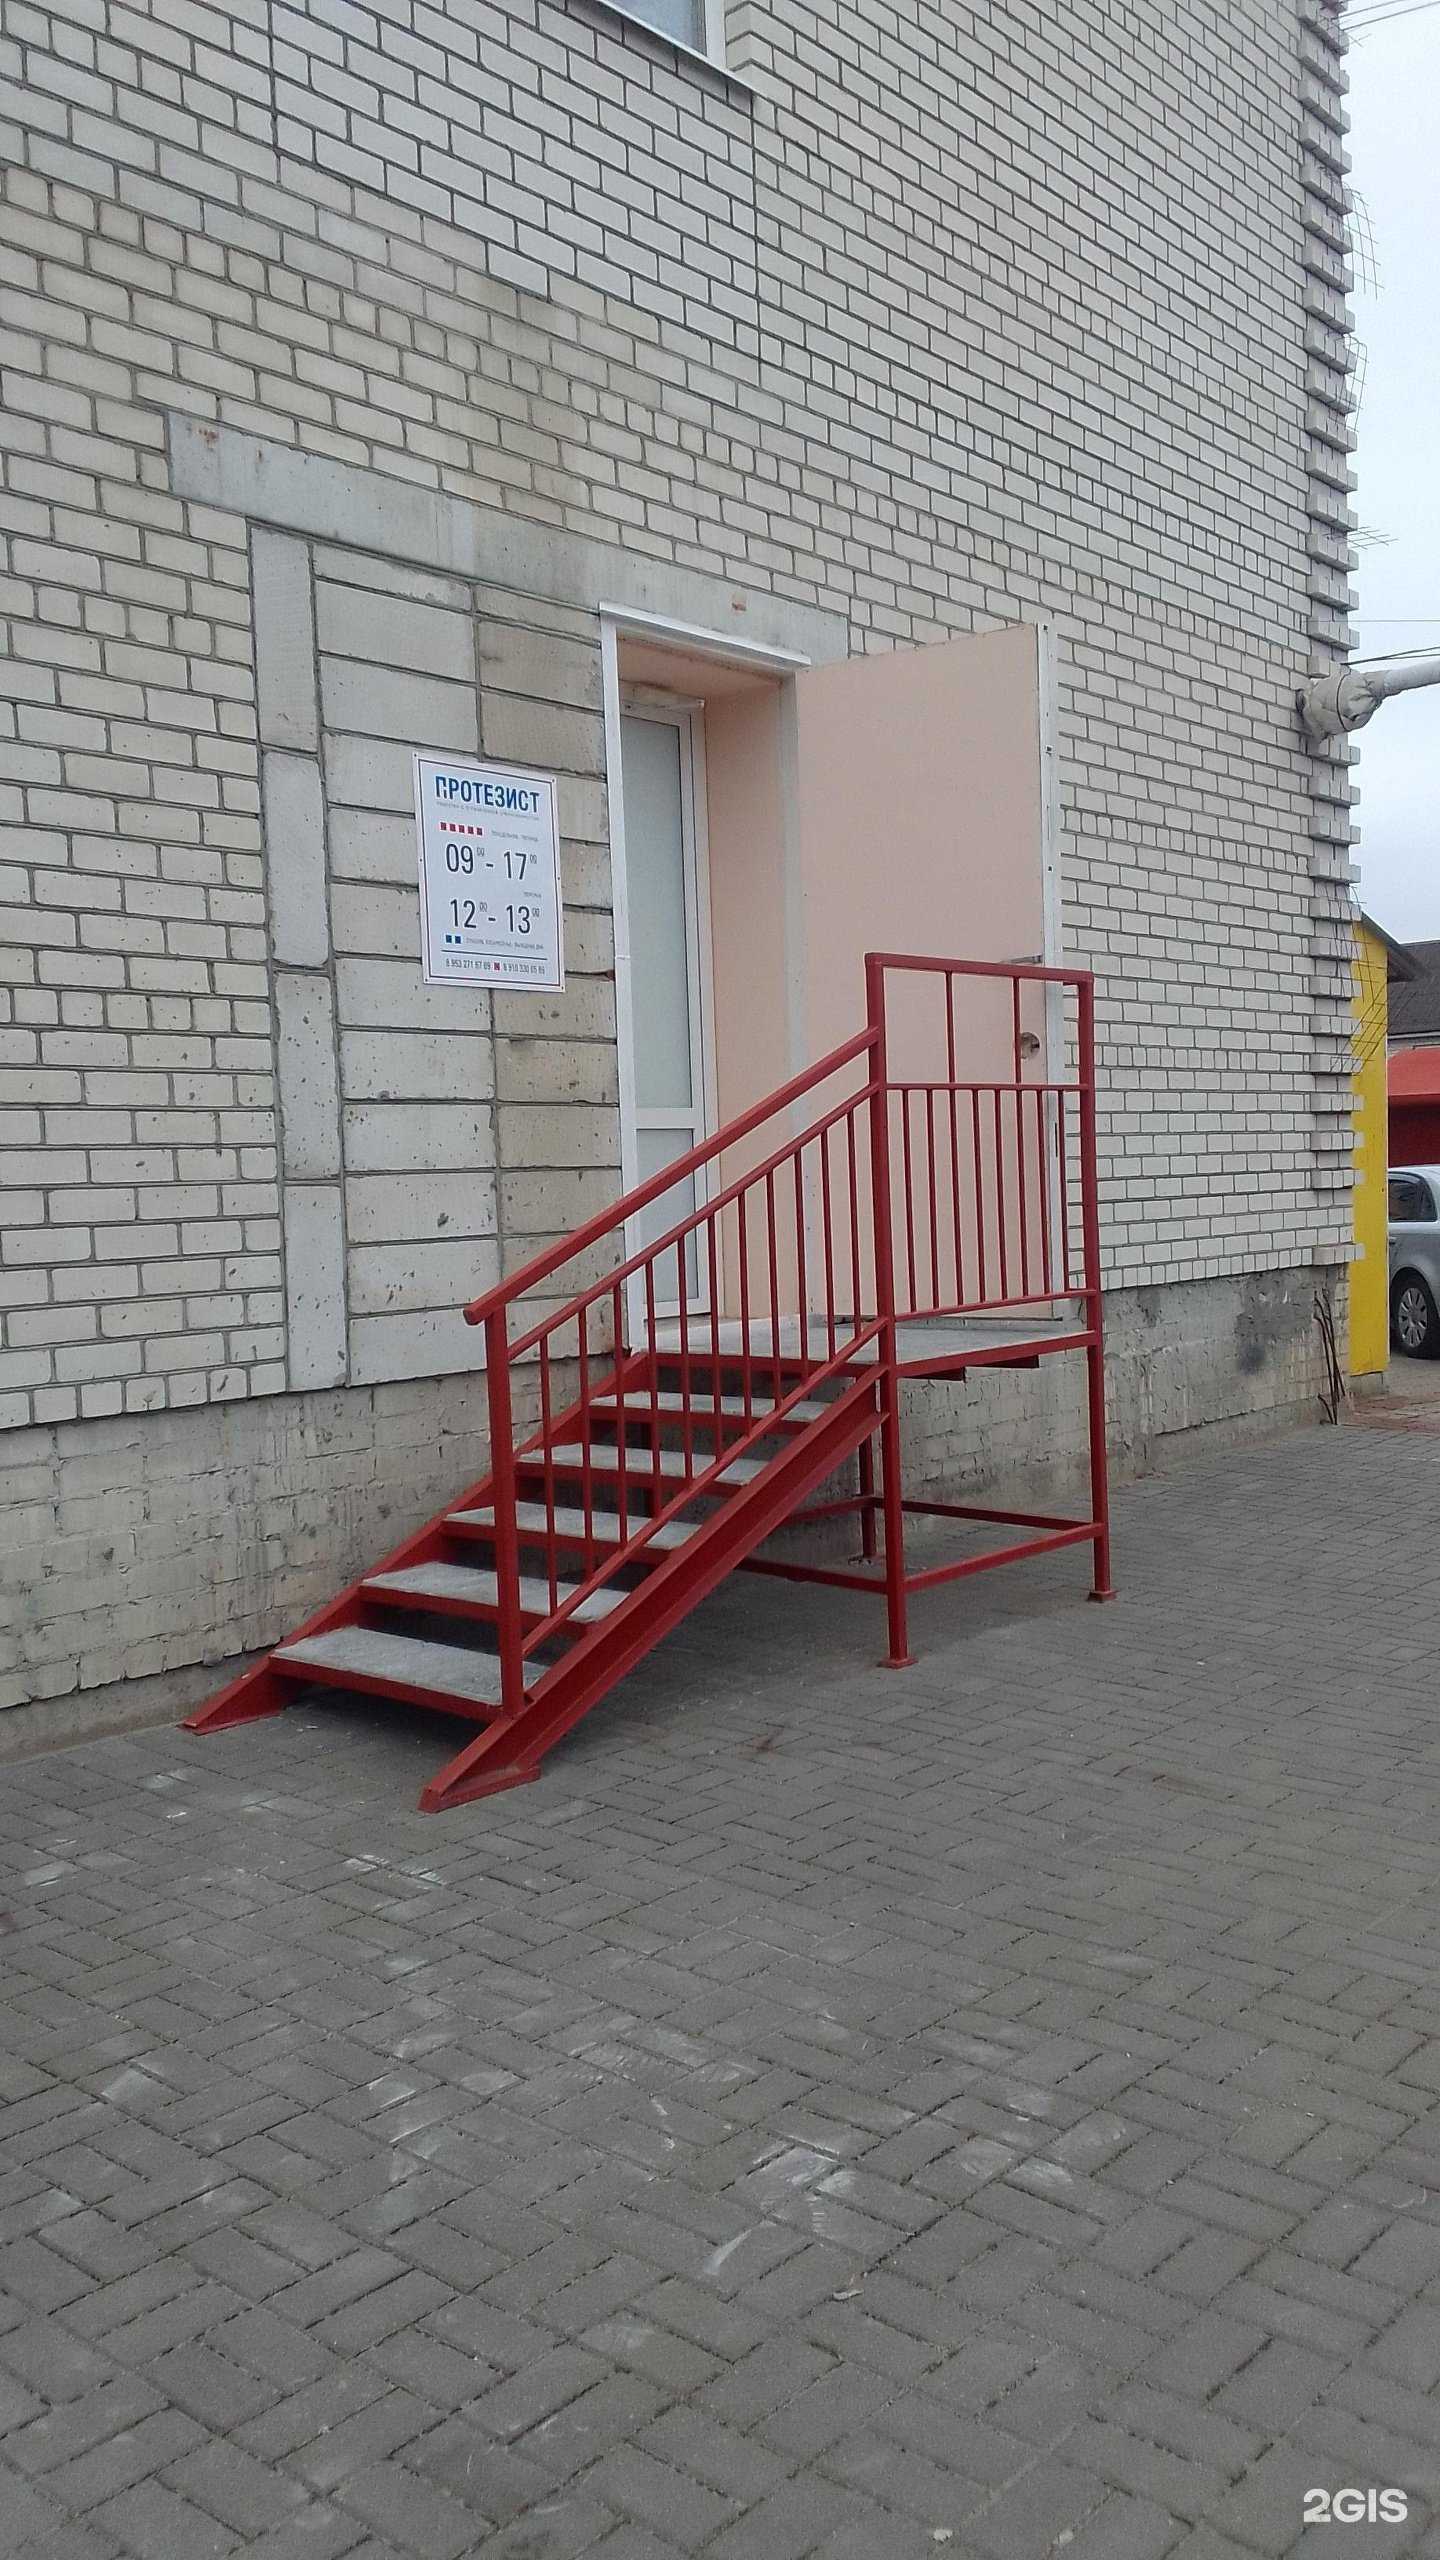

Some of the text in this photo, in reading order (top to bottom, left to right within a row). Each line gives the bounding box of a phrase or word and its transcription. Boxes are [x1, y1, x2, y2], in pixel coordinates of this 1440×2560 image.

[435, 775, 540, 813] ПРОТЕЗИСТ
[446, 843, 474, 874] 09
[503, 851, 527, 880] 17
[450, 899, 477, 928] 12
[506, 905, 531, 934] 13
